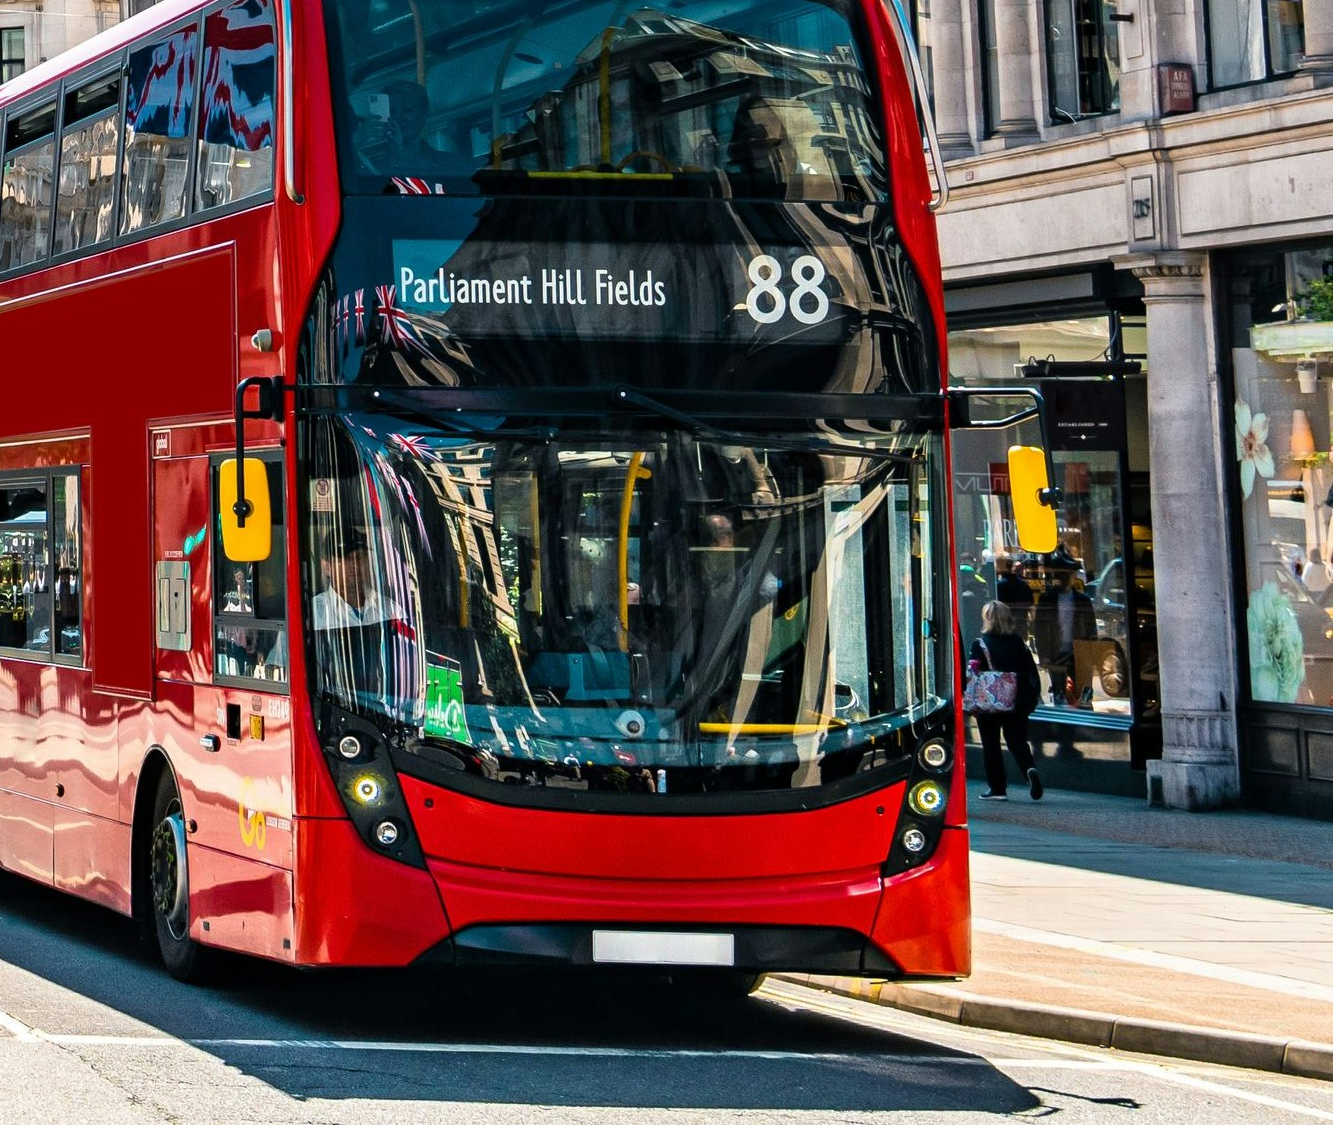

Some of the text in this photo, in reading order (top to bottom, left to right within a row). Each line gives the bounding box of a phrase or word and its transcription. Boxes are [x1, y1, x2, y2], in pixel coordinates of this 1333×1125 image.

[401, 267, 666, 306] Parliament Hill Fields
[746, 255, 829, 325] 88
